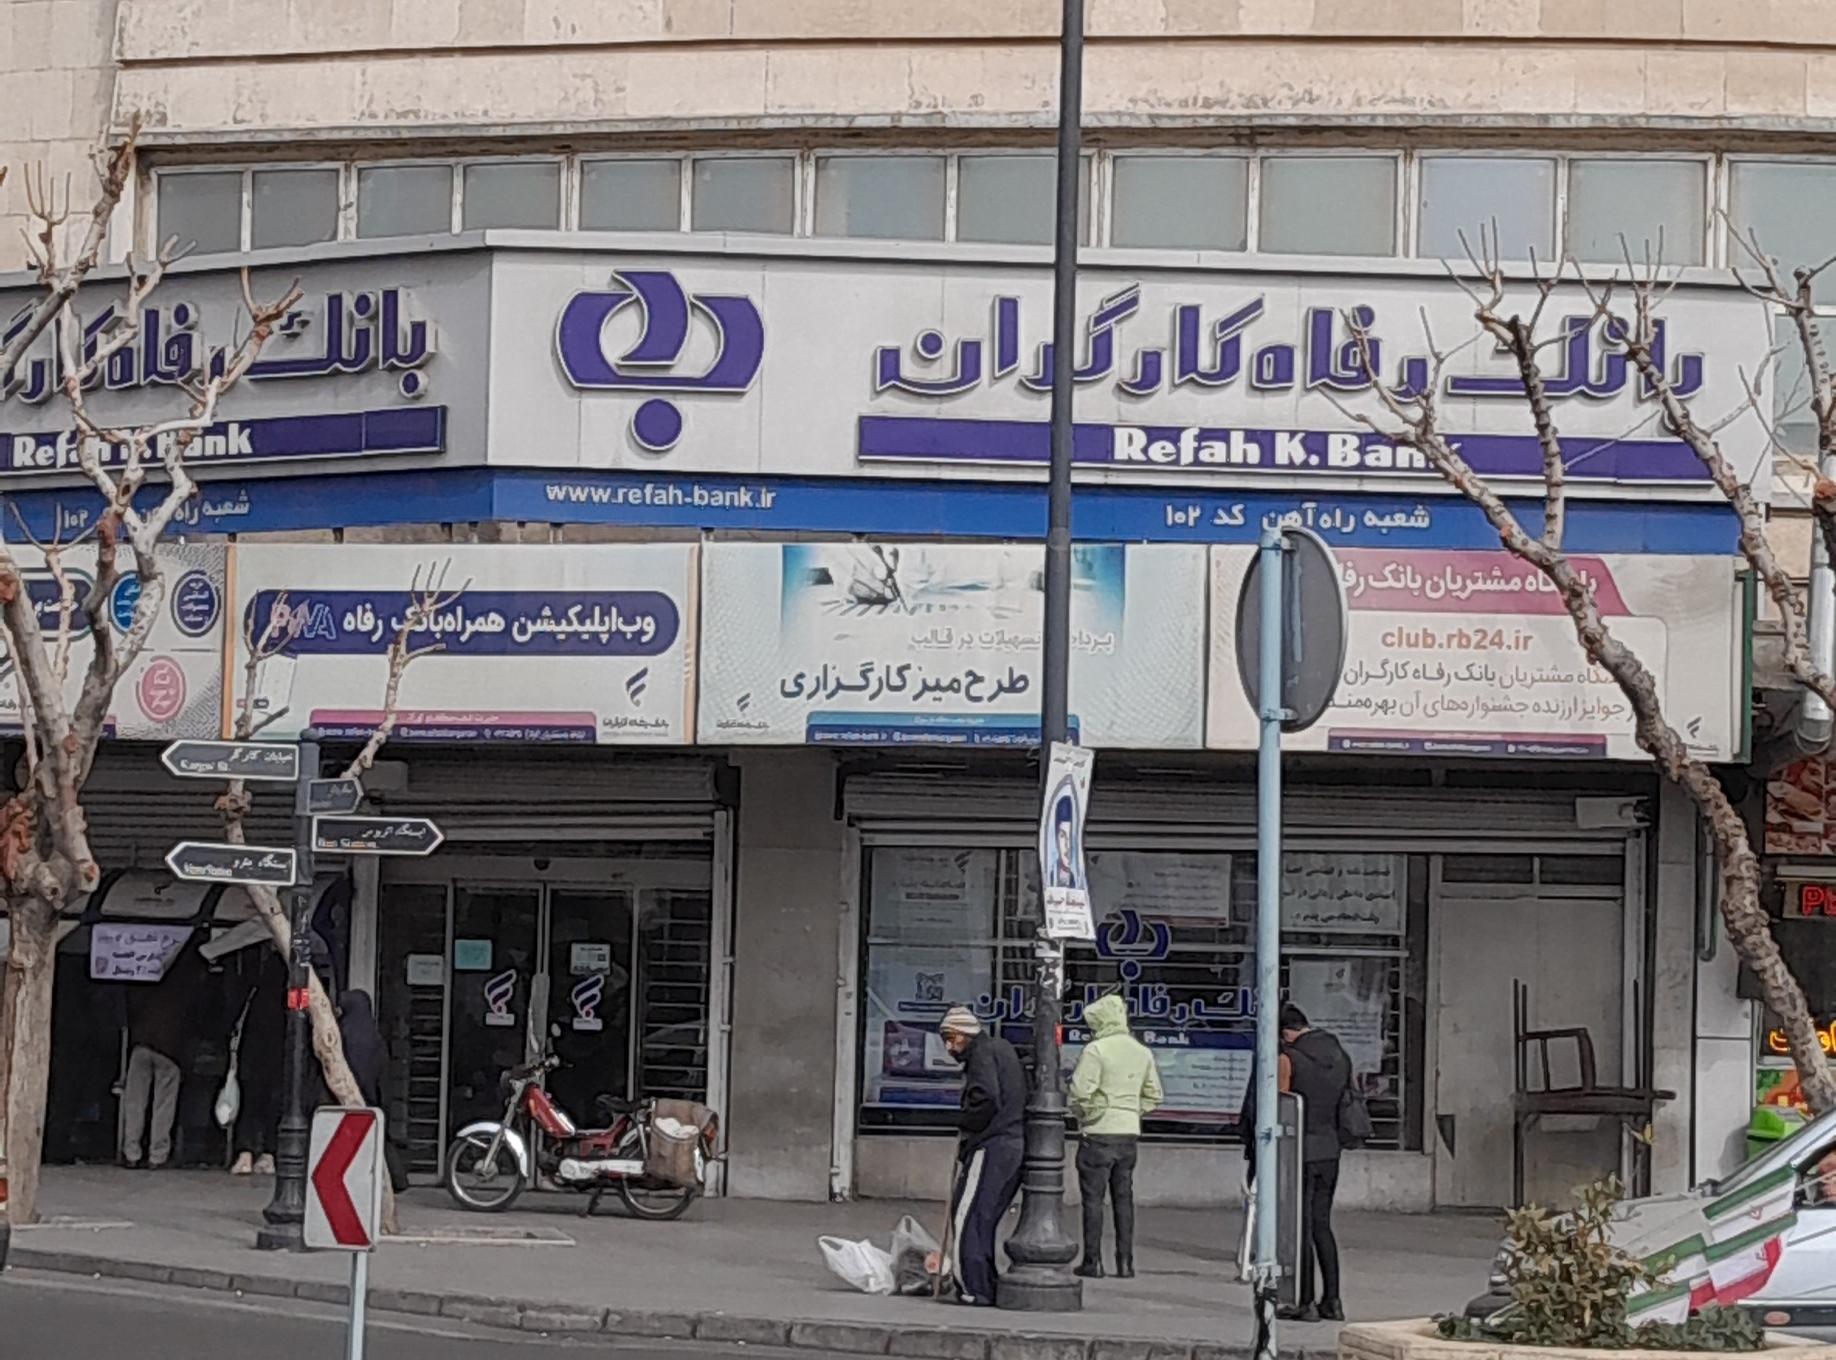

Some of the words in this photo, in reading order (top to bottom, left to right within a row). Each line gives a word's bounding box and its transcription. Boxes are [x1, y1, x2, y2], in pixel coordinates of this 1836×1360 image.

[232, 288, 434, 398] بانک
[875, 280, 1266, 396] کارگران
[1252, 304, 1430, 403] رفاه
[1448, 314, 1703, 436] بانک
[1112, 426, 1262, 468] Refah
[202, 489, 250, 524] شعبه
[546, 483, 777, 511] www.refah-bank.ir
[1212, 503, 1246, 527] کد
[1363, 504, 1431, 534] شعبه
[1367, 562, 1423, 597] بانک
[1425, 564, 1523, 601] مشتریان
[342, 602, 384, 643] رفاه
[1380, 625, 1534, 651] club.rb24.ir
[779, 662, 911, 702] کارگزاری
[911, 666, 962, 702] میز
[963, 666, 1030, 703] طرح
[1342, 658, 1410, 687] کارگران
[1411, 661, 1451, 688] رفاه
[1454, 662, 1497, 684] بانک
[1498, 664, 1574, 690] مشتریان
[1399, 690, 1421, 718] آن
[1532, 696, 1580, 721] ارزنده
[1578, 696, 1626, 722] جوایز
